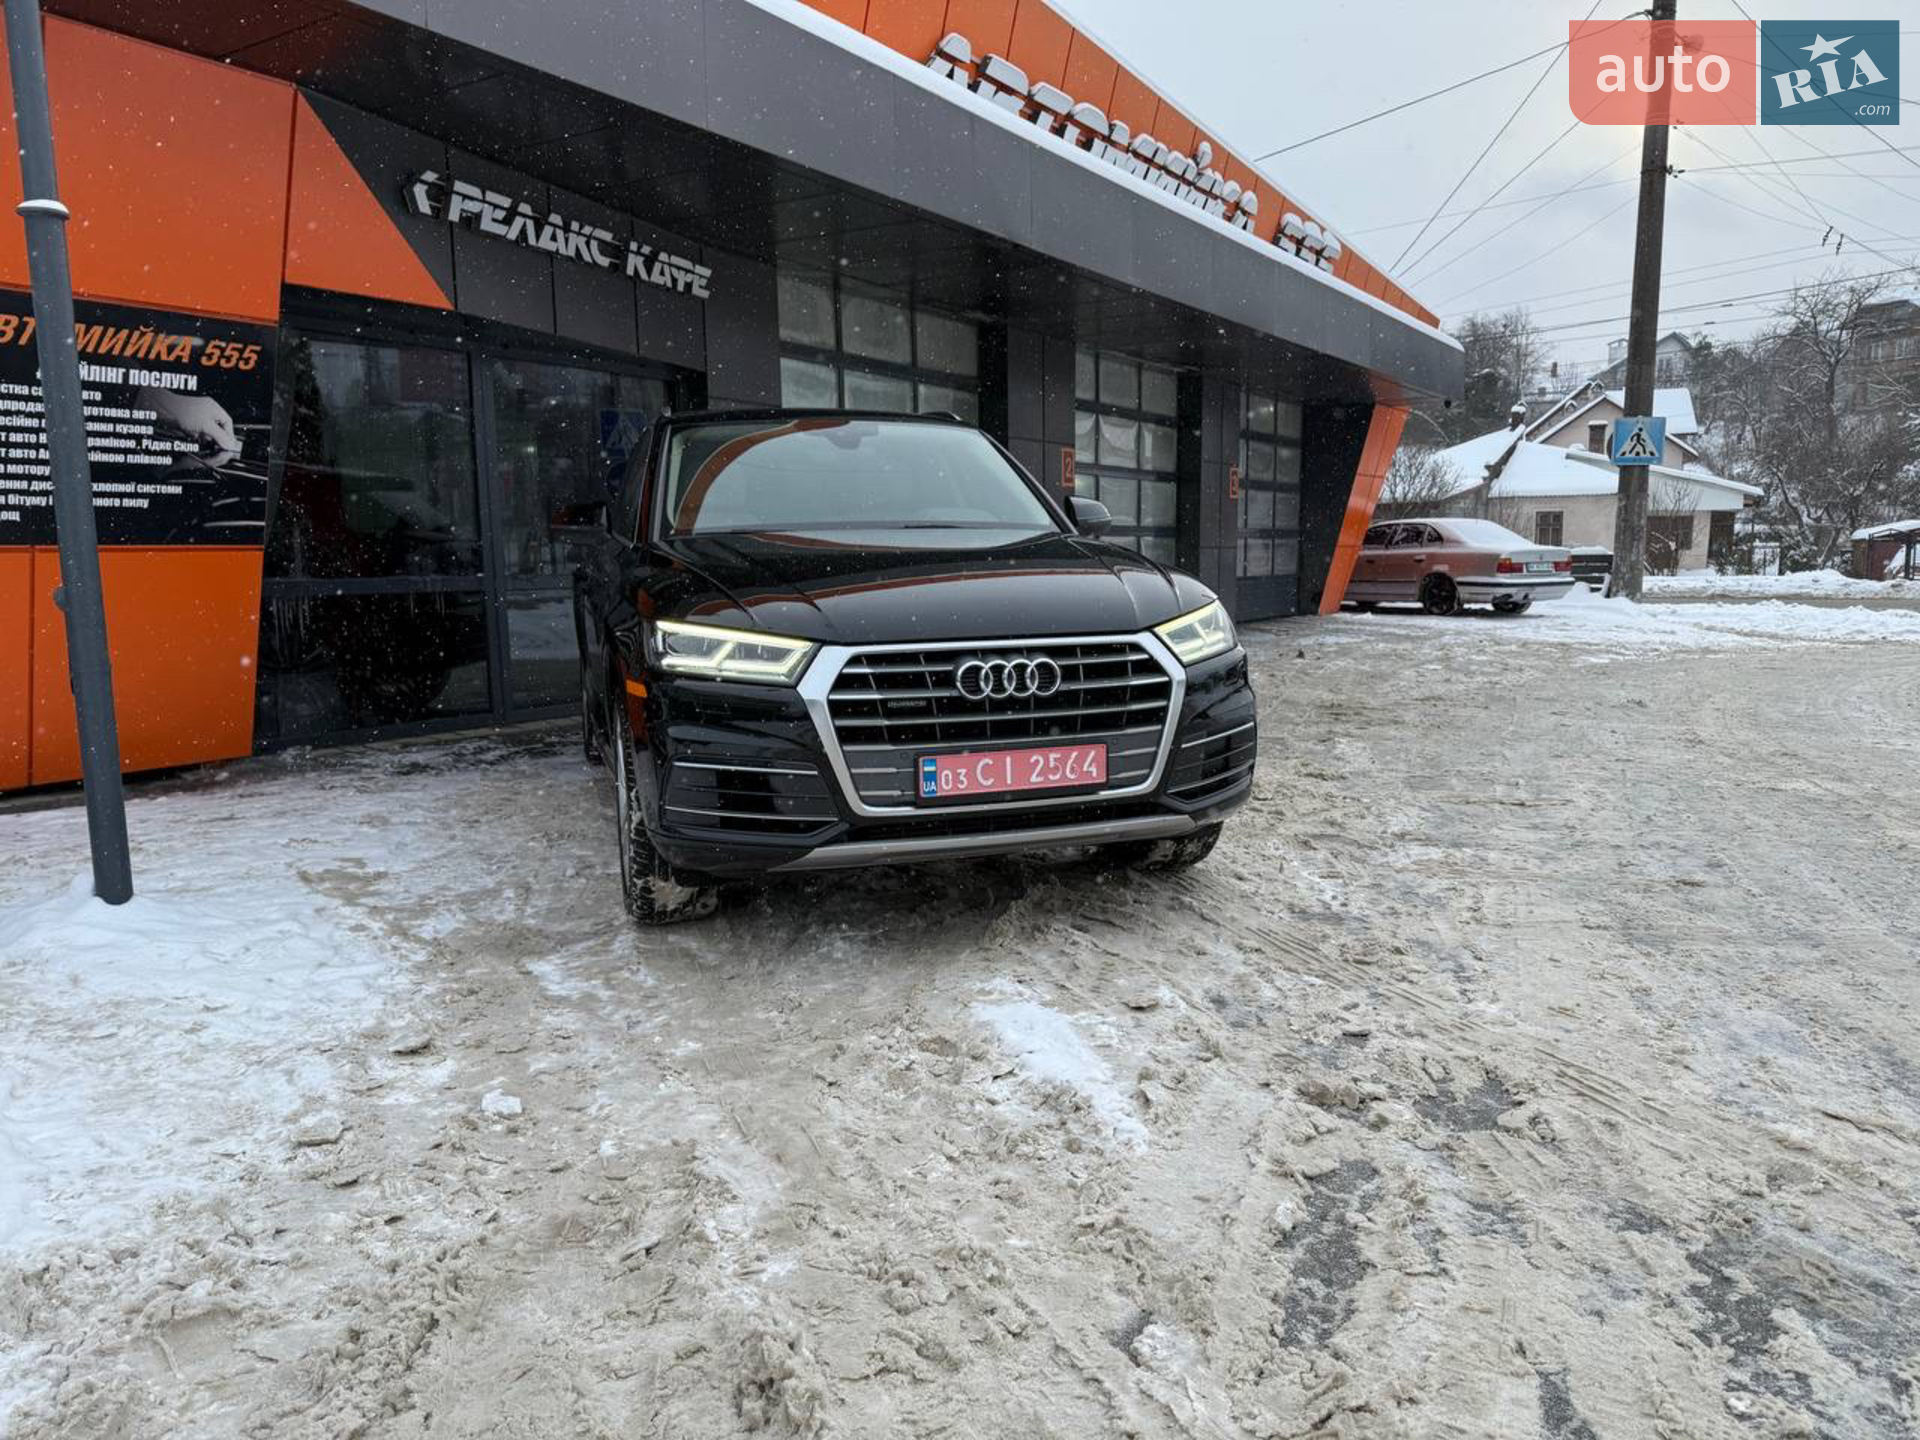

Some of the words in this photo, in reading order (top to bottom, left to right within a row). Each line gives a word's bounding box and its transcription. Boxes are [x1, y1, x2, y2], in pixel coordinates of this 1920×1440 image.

[447, 179, 615, 268] РЕЛАКС
[626, 240, 712, 299] КАФЕ
[0, 314, 192, 363] ВТМИЙКА
[201, 340, 261, 370] 555
[129, 368, 198, 391] ПОСЛУГИ
[81, 390, 102, 401] вто
[132, 410, 157, 420] авто
[115, 423, 154, 435] кузова
[9, 432, 37, 443] авто
[8, 448, 37, 459] авто
[7, 464, 51, 476] мотору
[1065, 456, 1072, 478] 2
[137, 484, 183, 495] системи
[1030, 750, 1099, 783] 2564
[923, 781, 937, 793] UA
